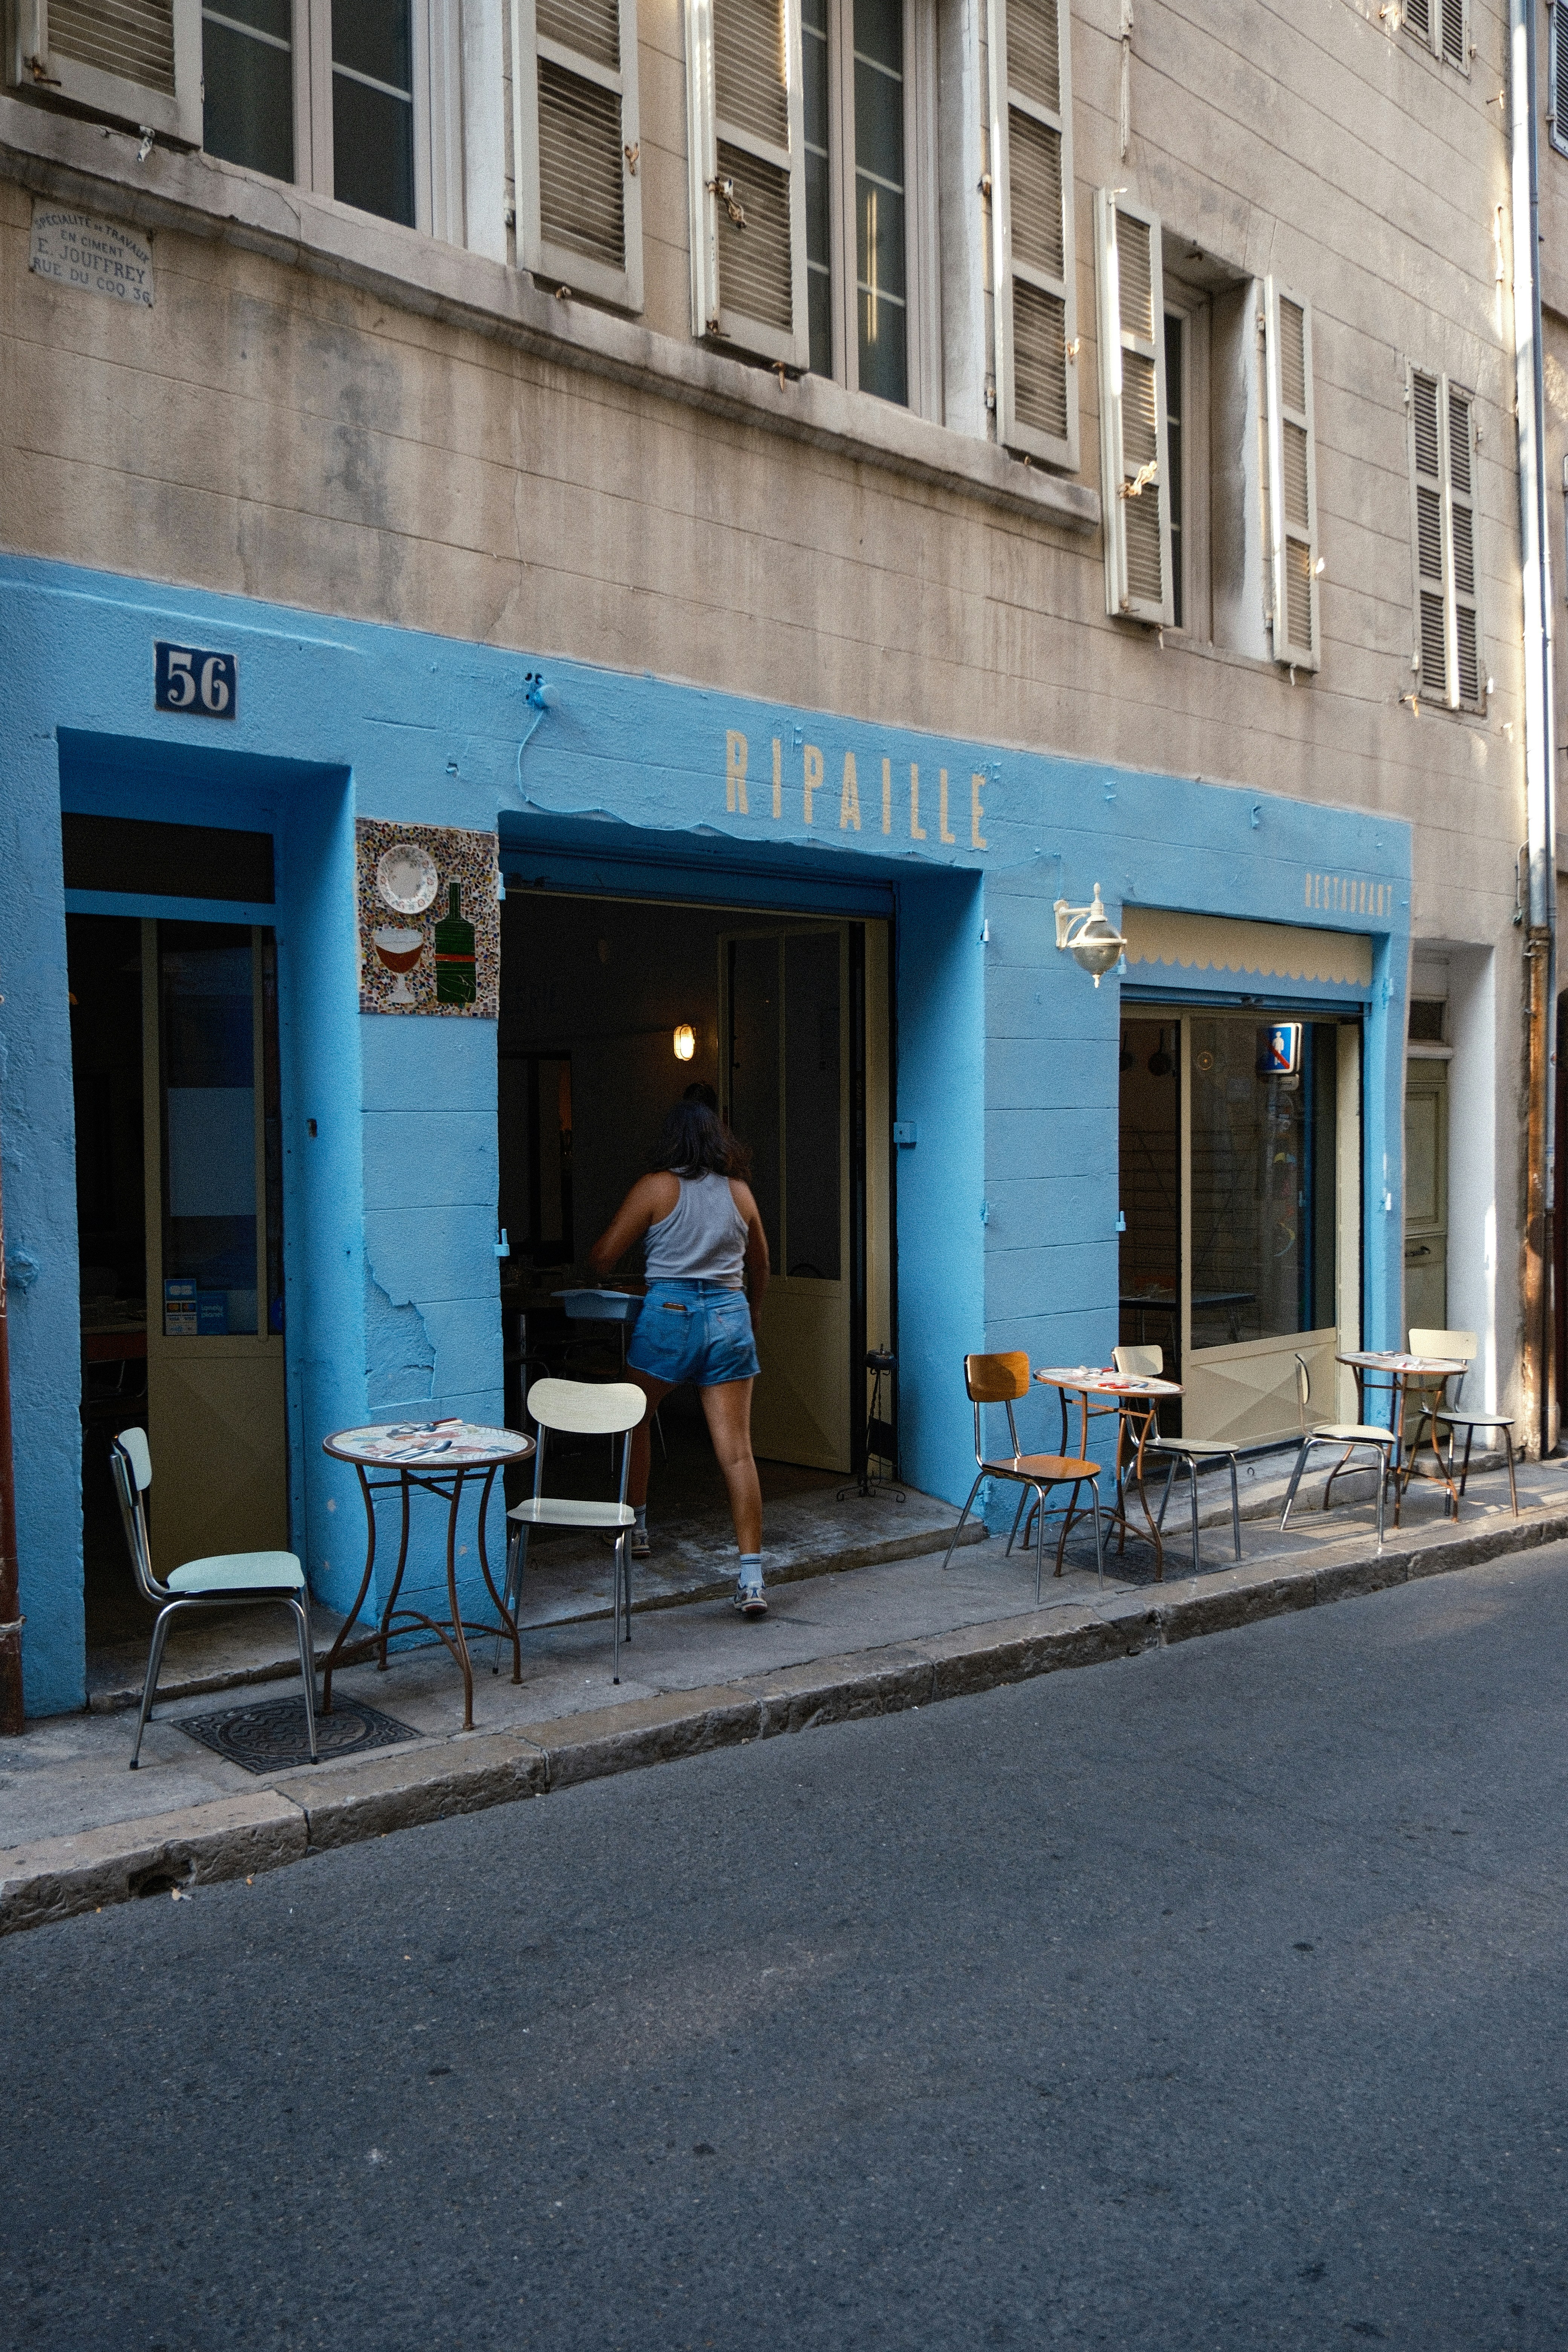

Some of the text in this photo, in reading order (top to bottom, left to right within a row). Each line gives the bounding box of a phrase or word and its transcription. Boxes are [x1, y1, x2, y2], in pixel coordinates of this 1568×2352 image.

[60, 230, 124, 257] EN CIMENT
[106, 225, 150, 264] TRAVAUX
[33, 257, 62, 276] RUE
[70, 269, 89, 285] DU
[97, 277, 126, 298] COQ
[60, 245, 146, 285] JOUFFREY
[168, 651, 229, 711] 56
[726, 730, 987, 849] RIPAILLE
